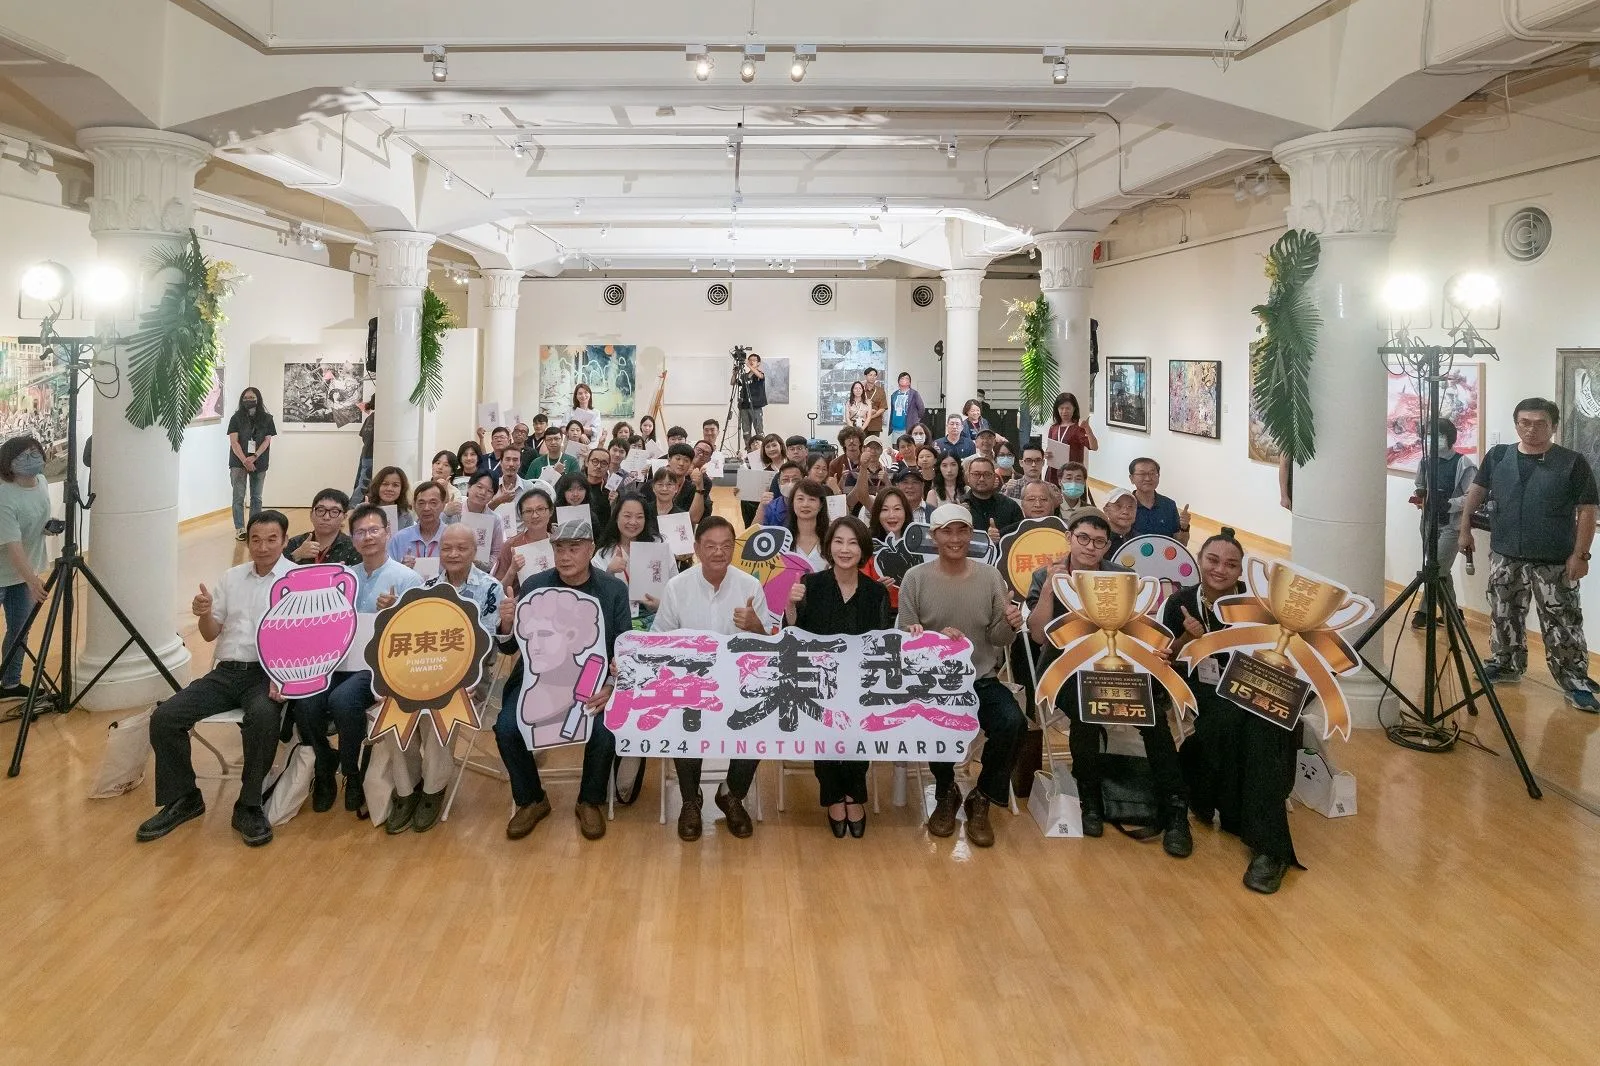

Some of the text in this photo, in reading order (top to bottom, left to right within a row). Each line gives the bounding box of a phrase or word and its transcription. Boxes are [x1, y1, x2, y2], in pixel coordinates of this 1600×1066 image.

[1093, 576, 1118, 620] 屏東獎
[387, 627, 465, 658] 屏東獎
[406, 656, 448, 666] PINGTUNG
[409, 664, 444, 673] AWARDS
[1229, 680, 1291, 719] 15萬元
[1088, 701, 1147, 718] 15萬元
[620, 738, 689, 753] 2024
